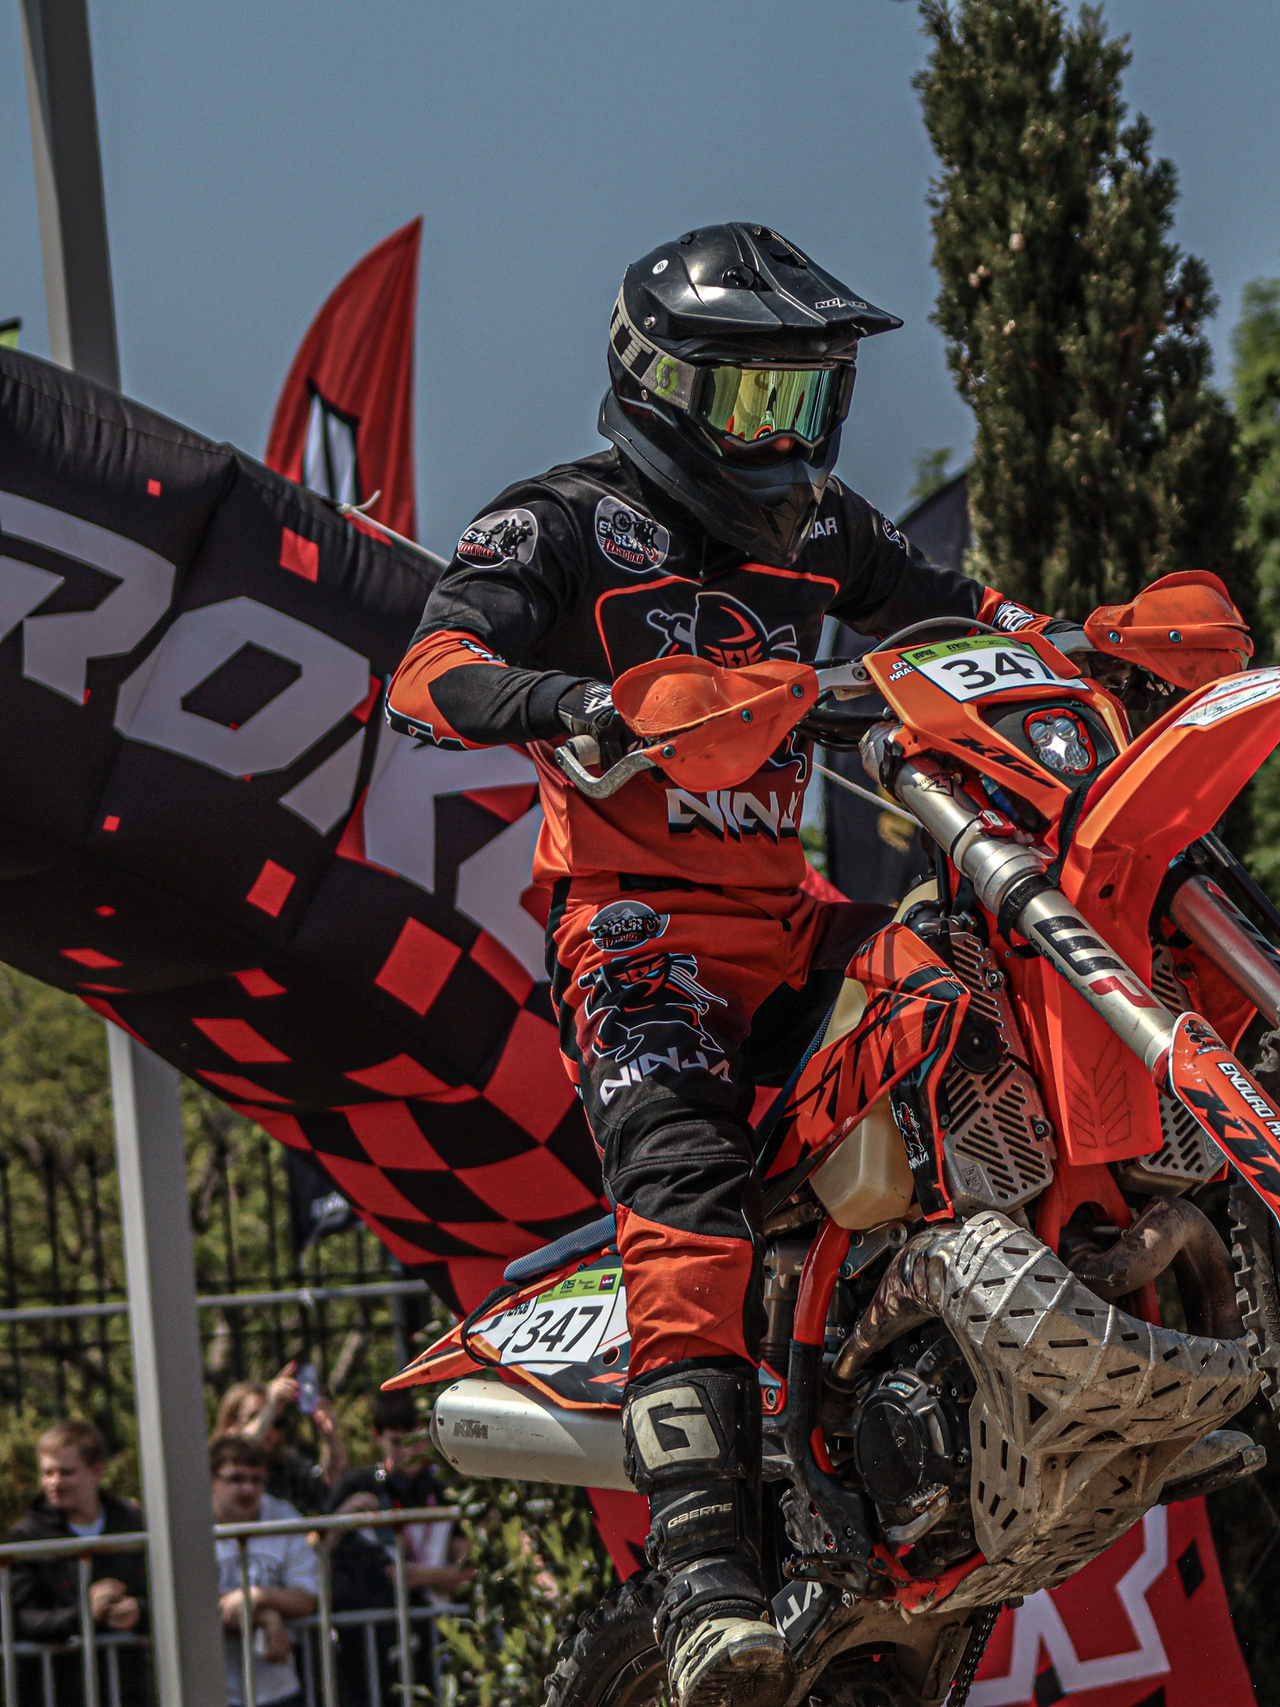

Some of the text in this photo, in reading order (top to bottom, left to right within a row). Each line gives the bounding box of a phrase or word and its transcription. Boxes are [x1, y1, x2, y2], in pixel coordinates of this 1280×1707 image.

[600, 1047, 734, 1106] NINJA
[1217, 1062, 1277, 1119] ENDURO
[511, 1305, 604, 1353] 347
[453, 1419, 489, 1440] KTM
[631, 1386, 720, 1470] G
